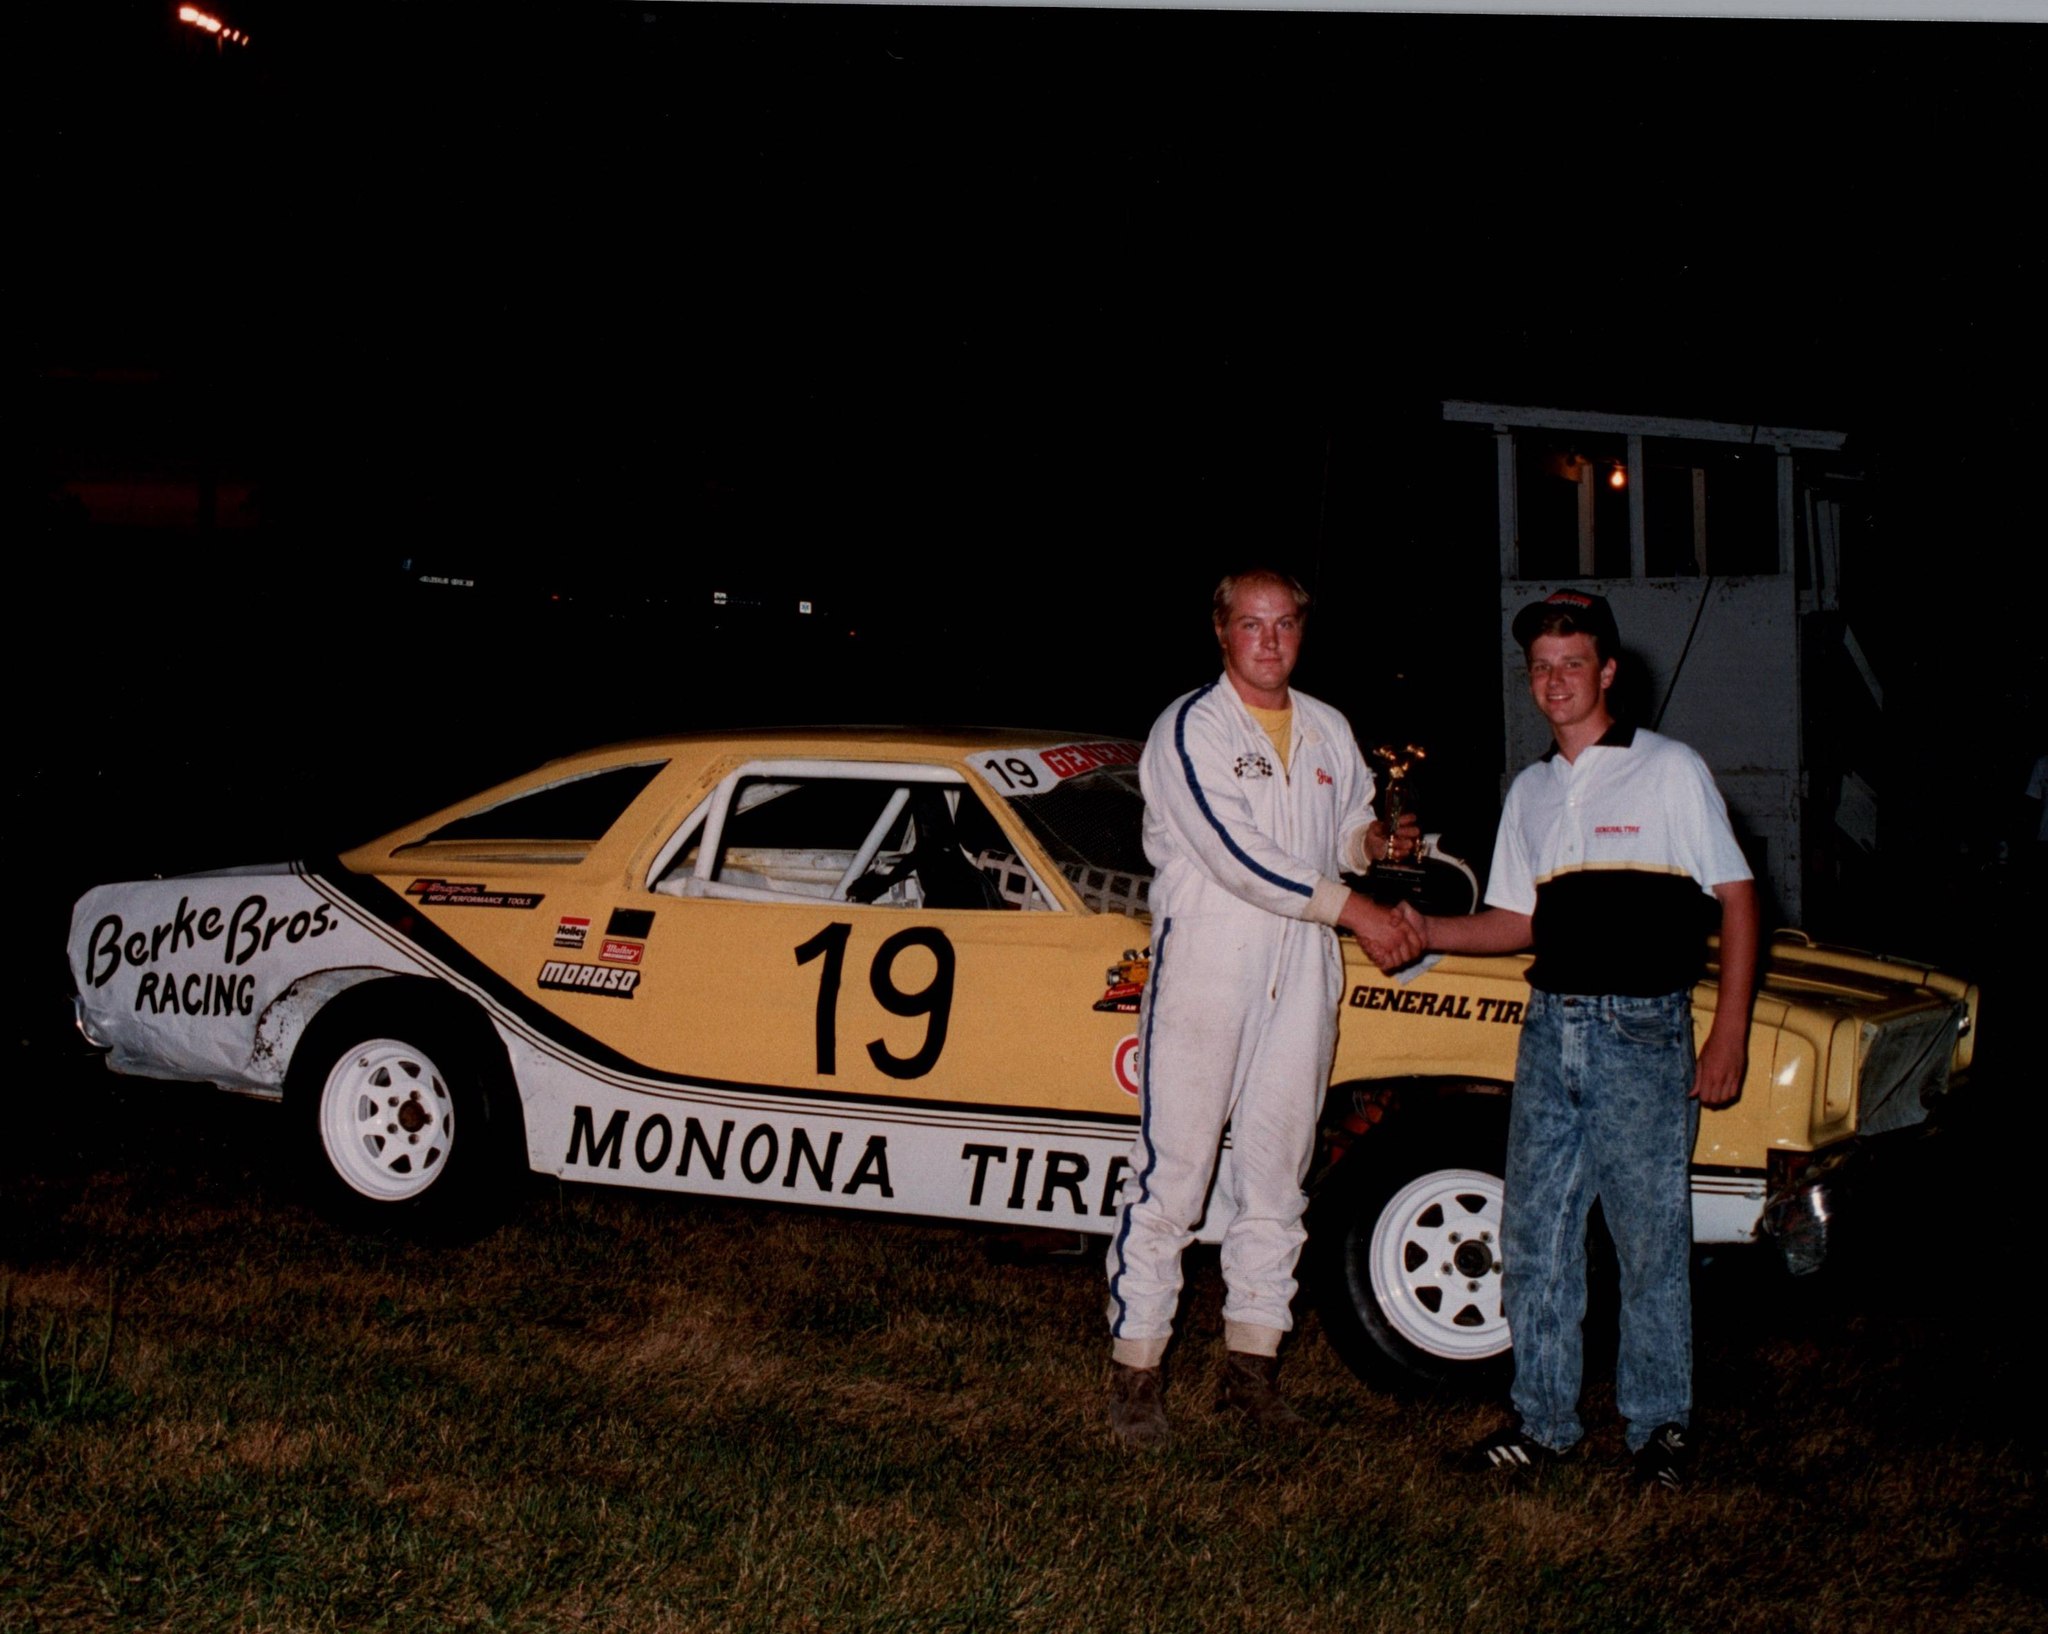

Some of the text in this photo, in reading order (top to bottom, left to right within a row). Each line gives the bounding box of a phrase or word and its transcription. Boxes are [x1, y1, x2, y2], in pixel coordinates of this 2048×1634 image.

[984, 758, 1038, 788] 19
[429, 894, 531, 906] HIGH PERFORMANCE TOOLS
[86, 895, 338, 989] Berke Bros.
[556, 925, 587, 940] Holley
[539, 961, 638, 992] MOROSO
[134, 972, 256, 1017] RACING
[793, 921, 956, 1080] 19
[1116, 1003, 1137, 1011] TEAM
[1349, 985, 1525, 1024] GENERAL TIR
[565, 1105, 895, 1198] MONONA
